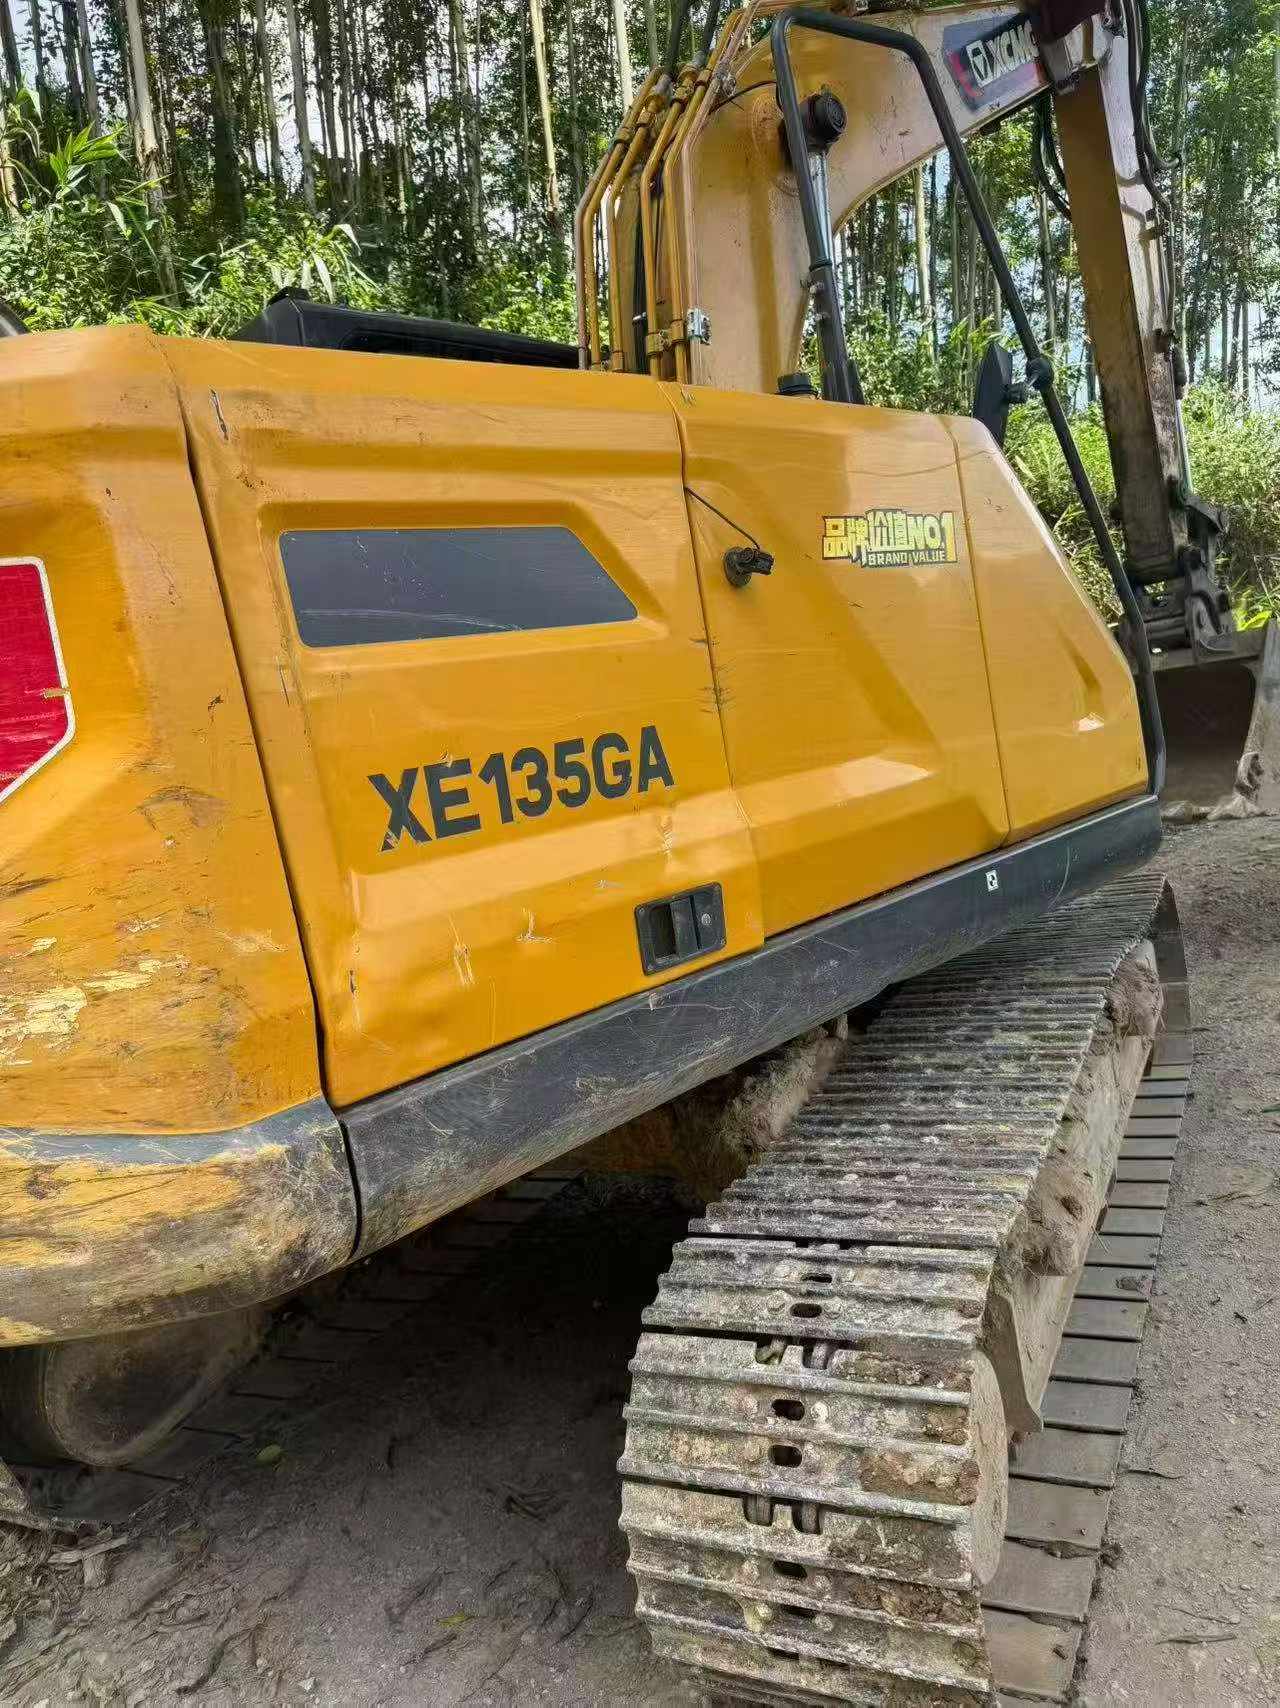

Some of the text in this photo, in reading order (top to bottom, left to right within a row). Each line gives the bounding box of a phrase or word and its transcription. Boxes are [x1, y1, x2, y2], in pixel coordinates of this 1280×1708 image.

[868, 550, 946, 566] BRAND VALUE
[367, 725, 675, 852] XE135GA
